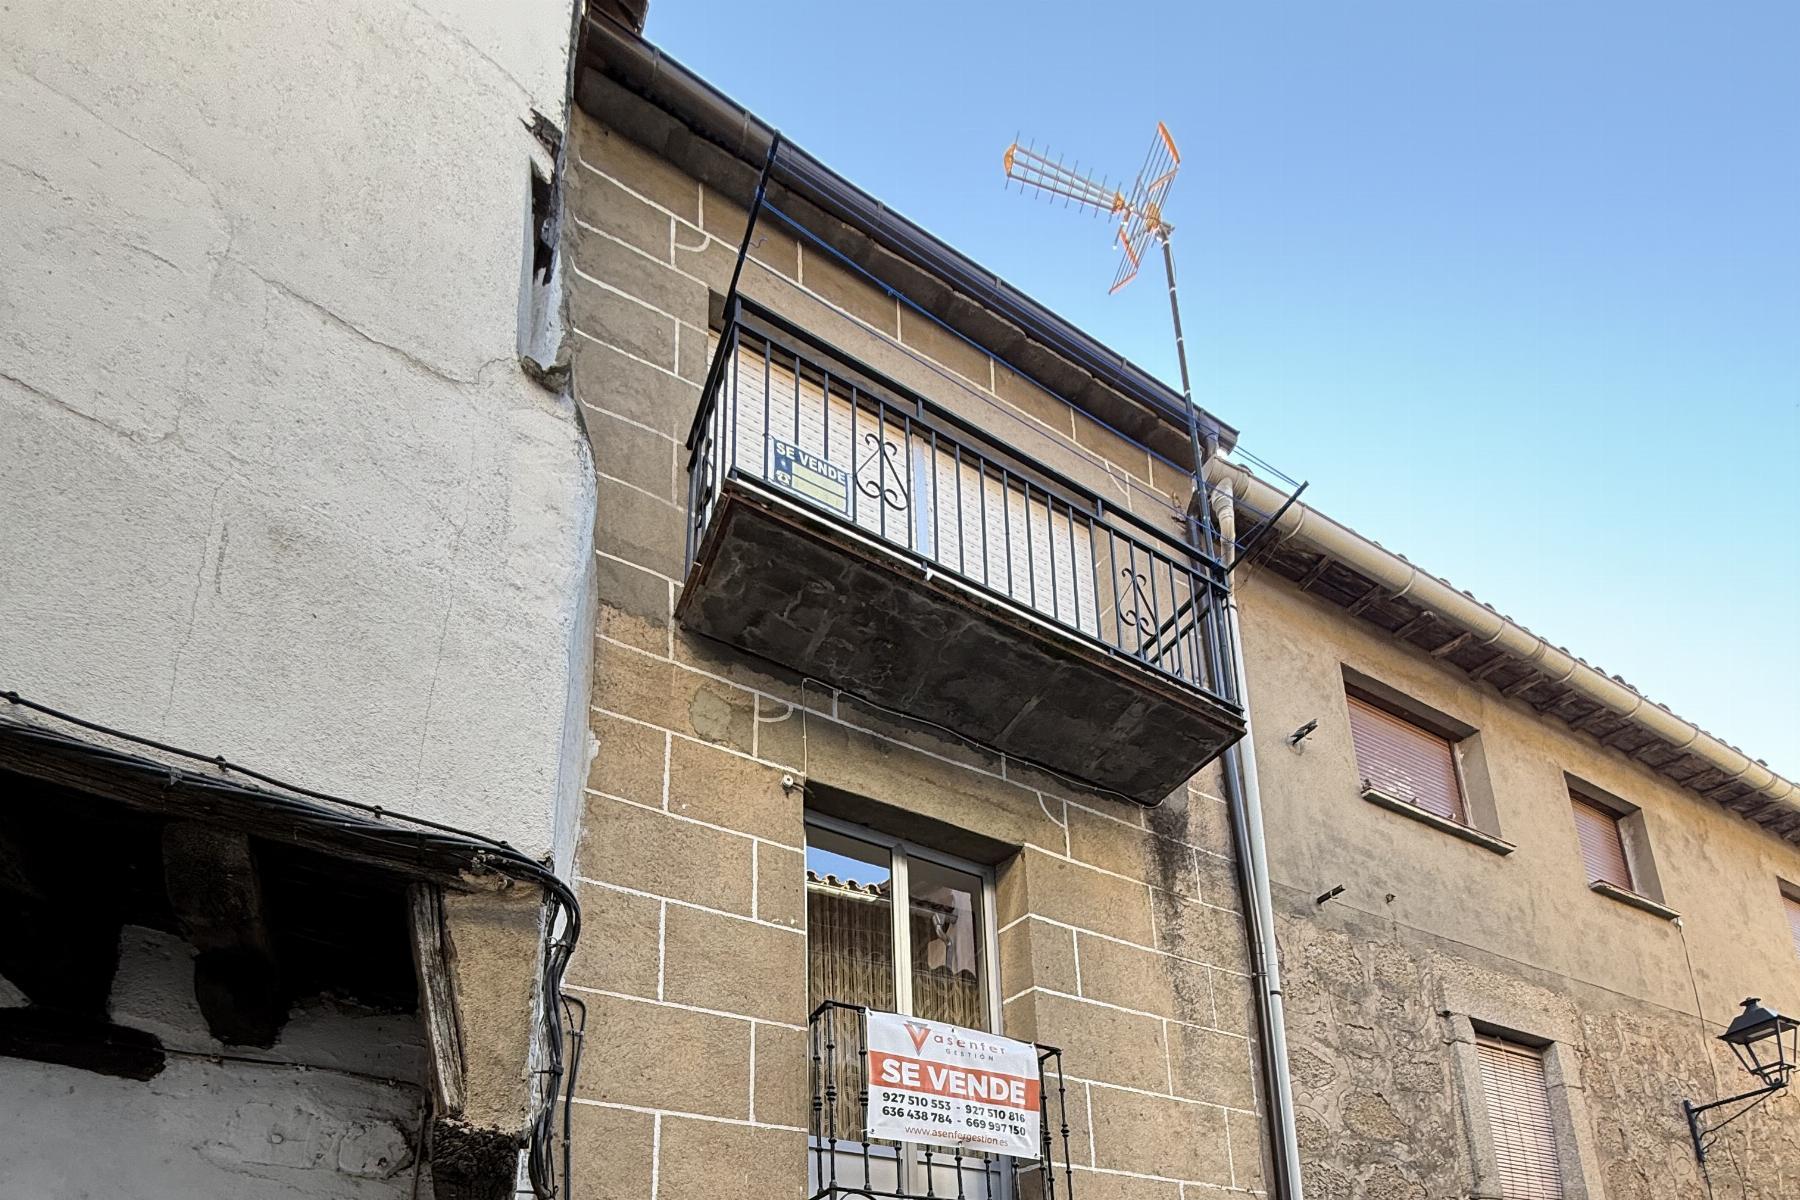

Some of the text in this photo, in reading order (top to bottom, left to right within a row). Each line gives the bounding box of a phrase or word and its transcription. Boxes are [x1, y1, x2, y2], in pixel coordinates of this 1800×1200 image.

[776, 442, 847, 485] SE VENDE
[933, 1035, 1005, 1054] asenfer
[881, 1059, 1026, 1105] SE VENDE
[882, 1092, 905, 1103] 927
[907, 1095, 928, 1107] 510
[930, 1099, 951, 1110] 553
[965, 1104, 985, 1116] 927
[987, 1108, 1006, 1120] 510
[1008, 1112, 1026, 1123] 816
[882, 1106, 905, 1118] 636
[906, 1109, 929, 1121] 438
[930, 1112, 952, 1124] 784
[966, 1117, 986, 1129] 669
[988, 1121, 1007, 1133] 997
[1009, 1125, 1026, 1136] 150
